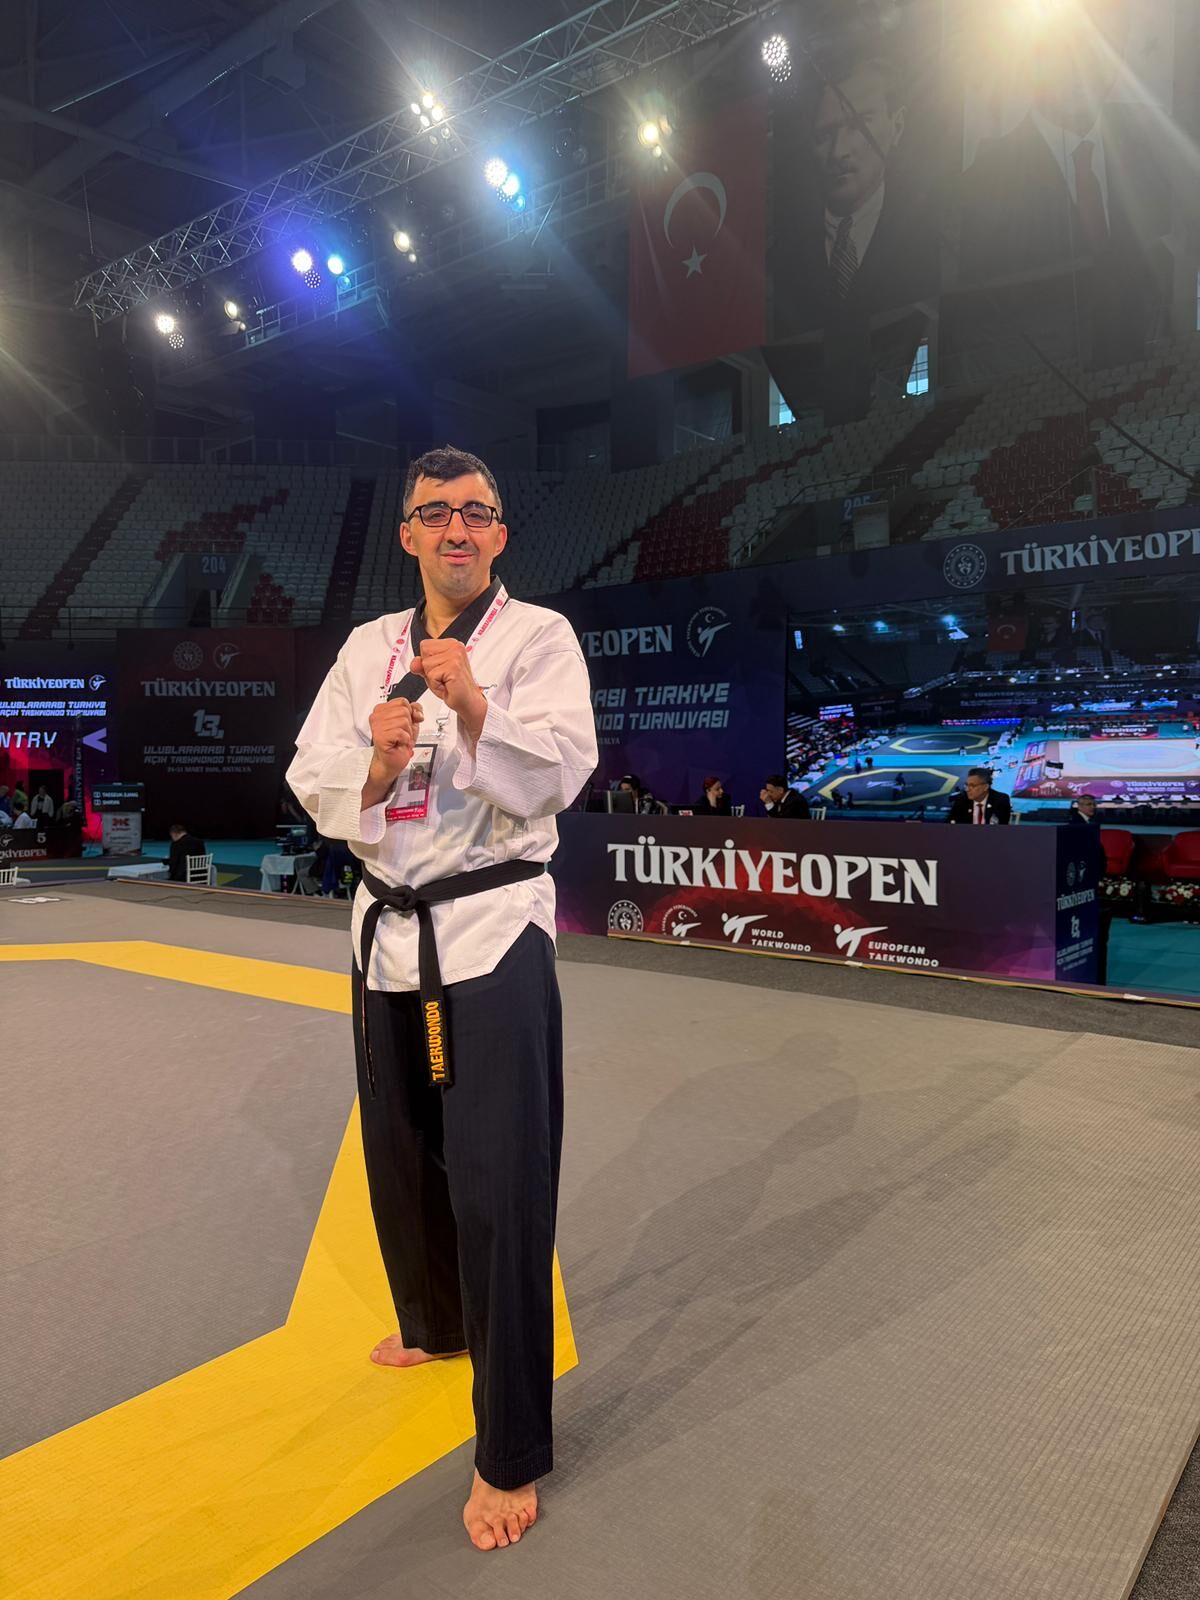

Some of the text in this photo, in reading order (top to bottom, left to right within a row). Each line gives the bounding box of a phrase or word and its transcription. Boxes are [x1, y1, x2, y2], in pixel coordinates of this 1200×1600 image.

[201, 556, 226, 574] 204
[4, 677, 85, 689] TÜRKİYEOPEN
[140, 678, 276, 697] TÜRKİYEOPEN
[592, 683, 730, 708] ASI TÜRKİYE
[629, 710, 729, 730] TURNUVASI
[37, 832, 47, 844] 5
[607, 835, 939, 906] TÜRKİYEOPEN
[751, 928, 784, 939] WORLD
[751, 939, 811, 952] TAEKWONDO
[868, 941, 926, 955] EUROPEAN
[868, 952, 940, 967] TAEKWONDO
[425, 1001, 446, 1081] TAEKWONDO
